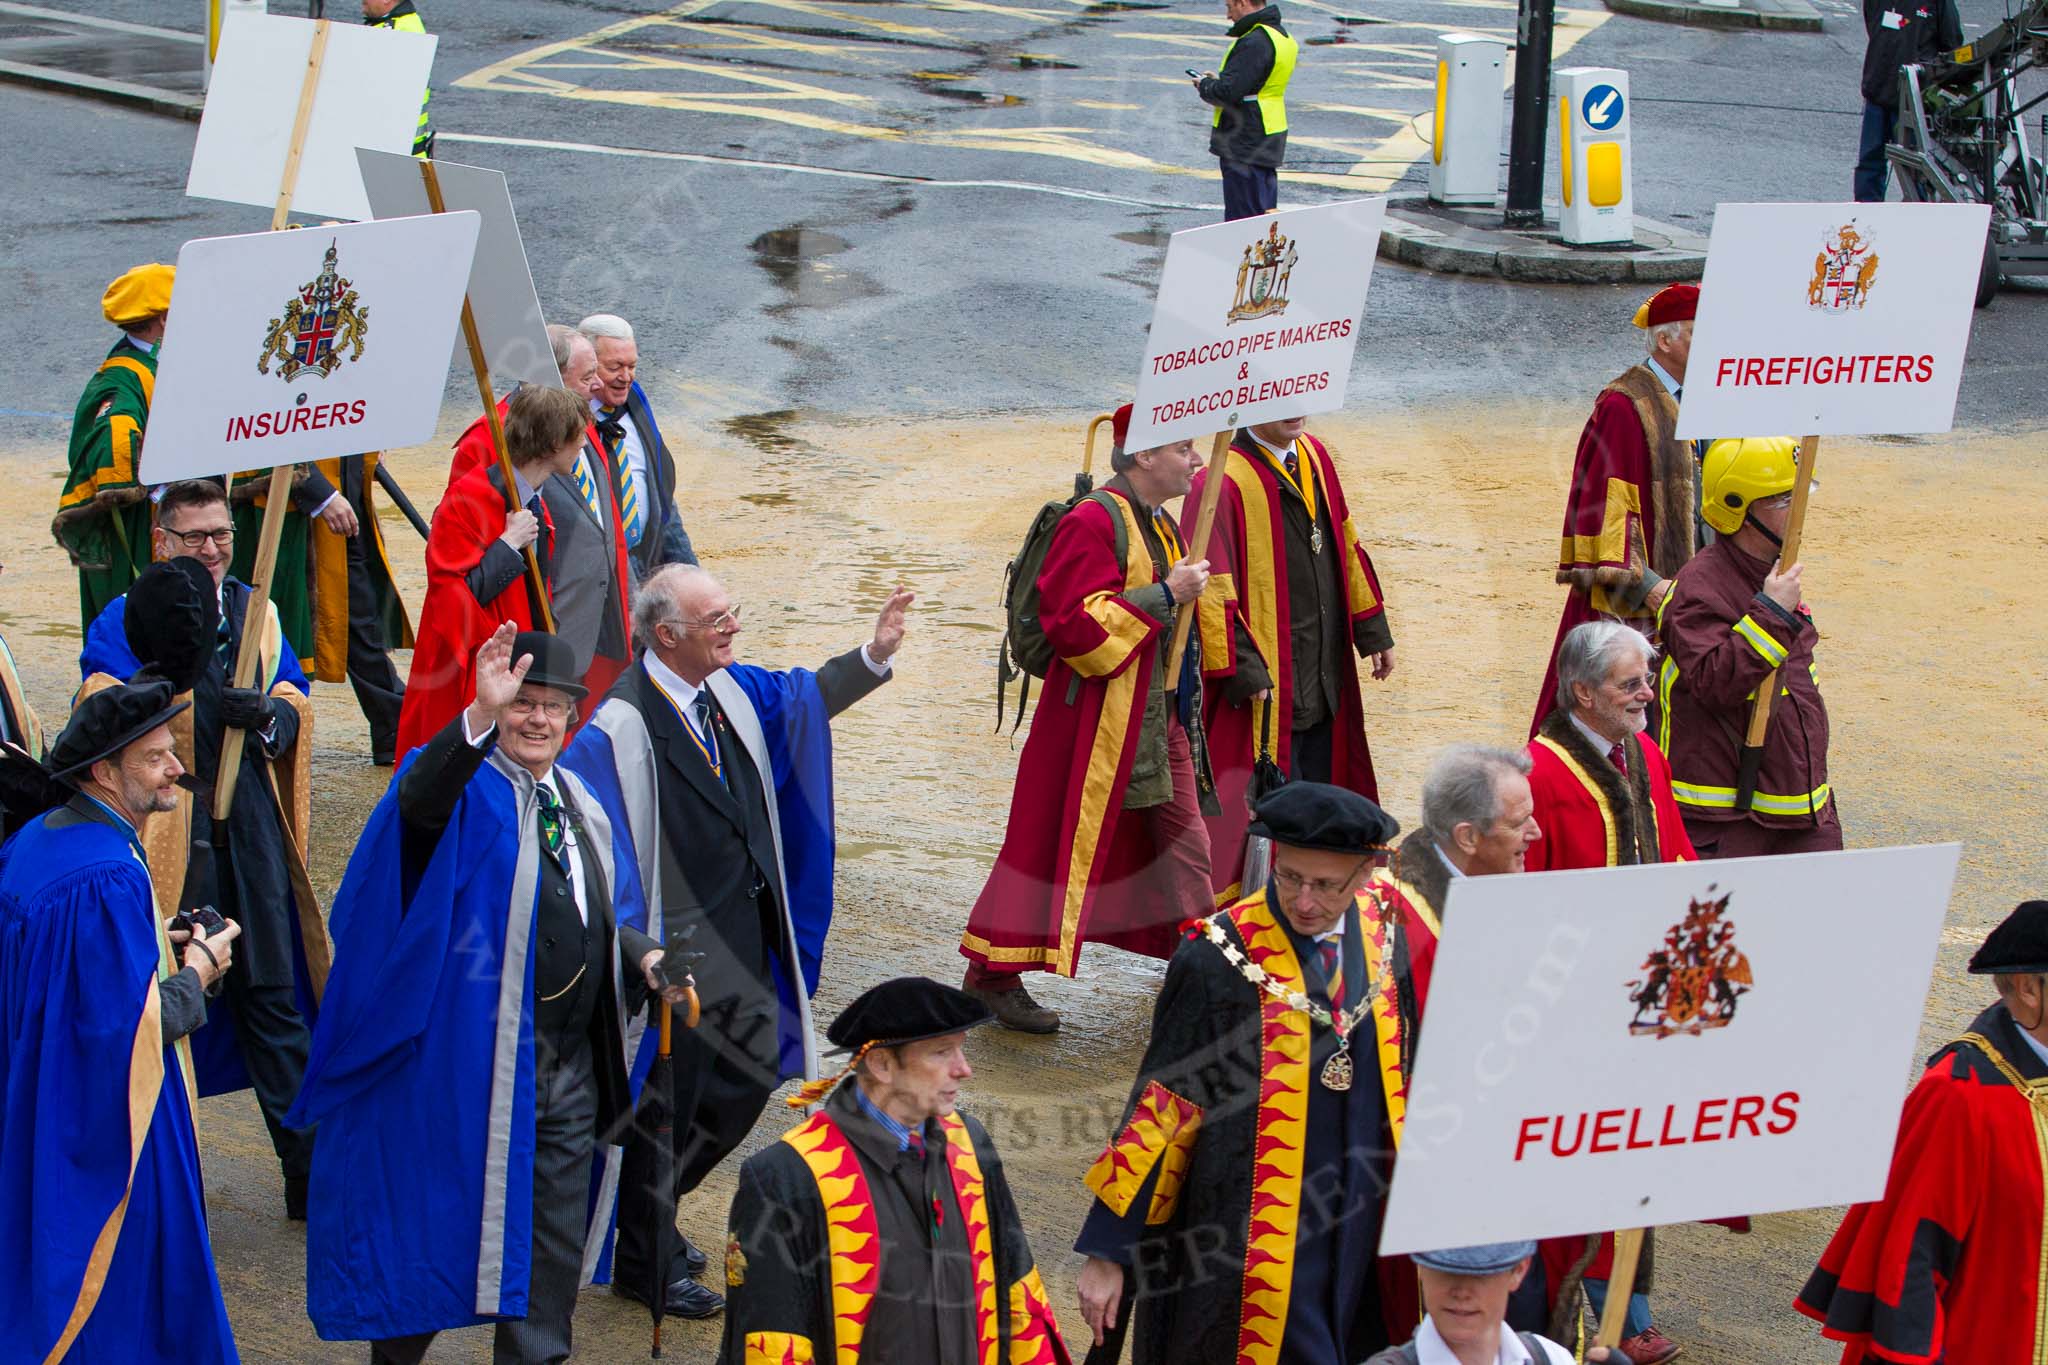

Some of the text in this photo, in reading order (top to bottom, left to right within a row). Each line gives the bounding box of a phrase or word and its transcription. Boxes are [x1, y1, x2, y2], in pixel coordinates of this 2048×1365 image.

[1152, 318, 1352, 375] TOBACCO PIPE MAKERS
[1714, 353, 1935, 388] FIREFIGHTERS
[1237, 362, 1249, 381] &
[225, 399, 367, 442] INSURERS
[1152, 371, 1329, 425] TOBACCO BLENDERS
[1513, 1090, 1801, 1163] FUELLERS
